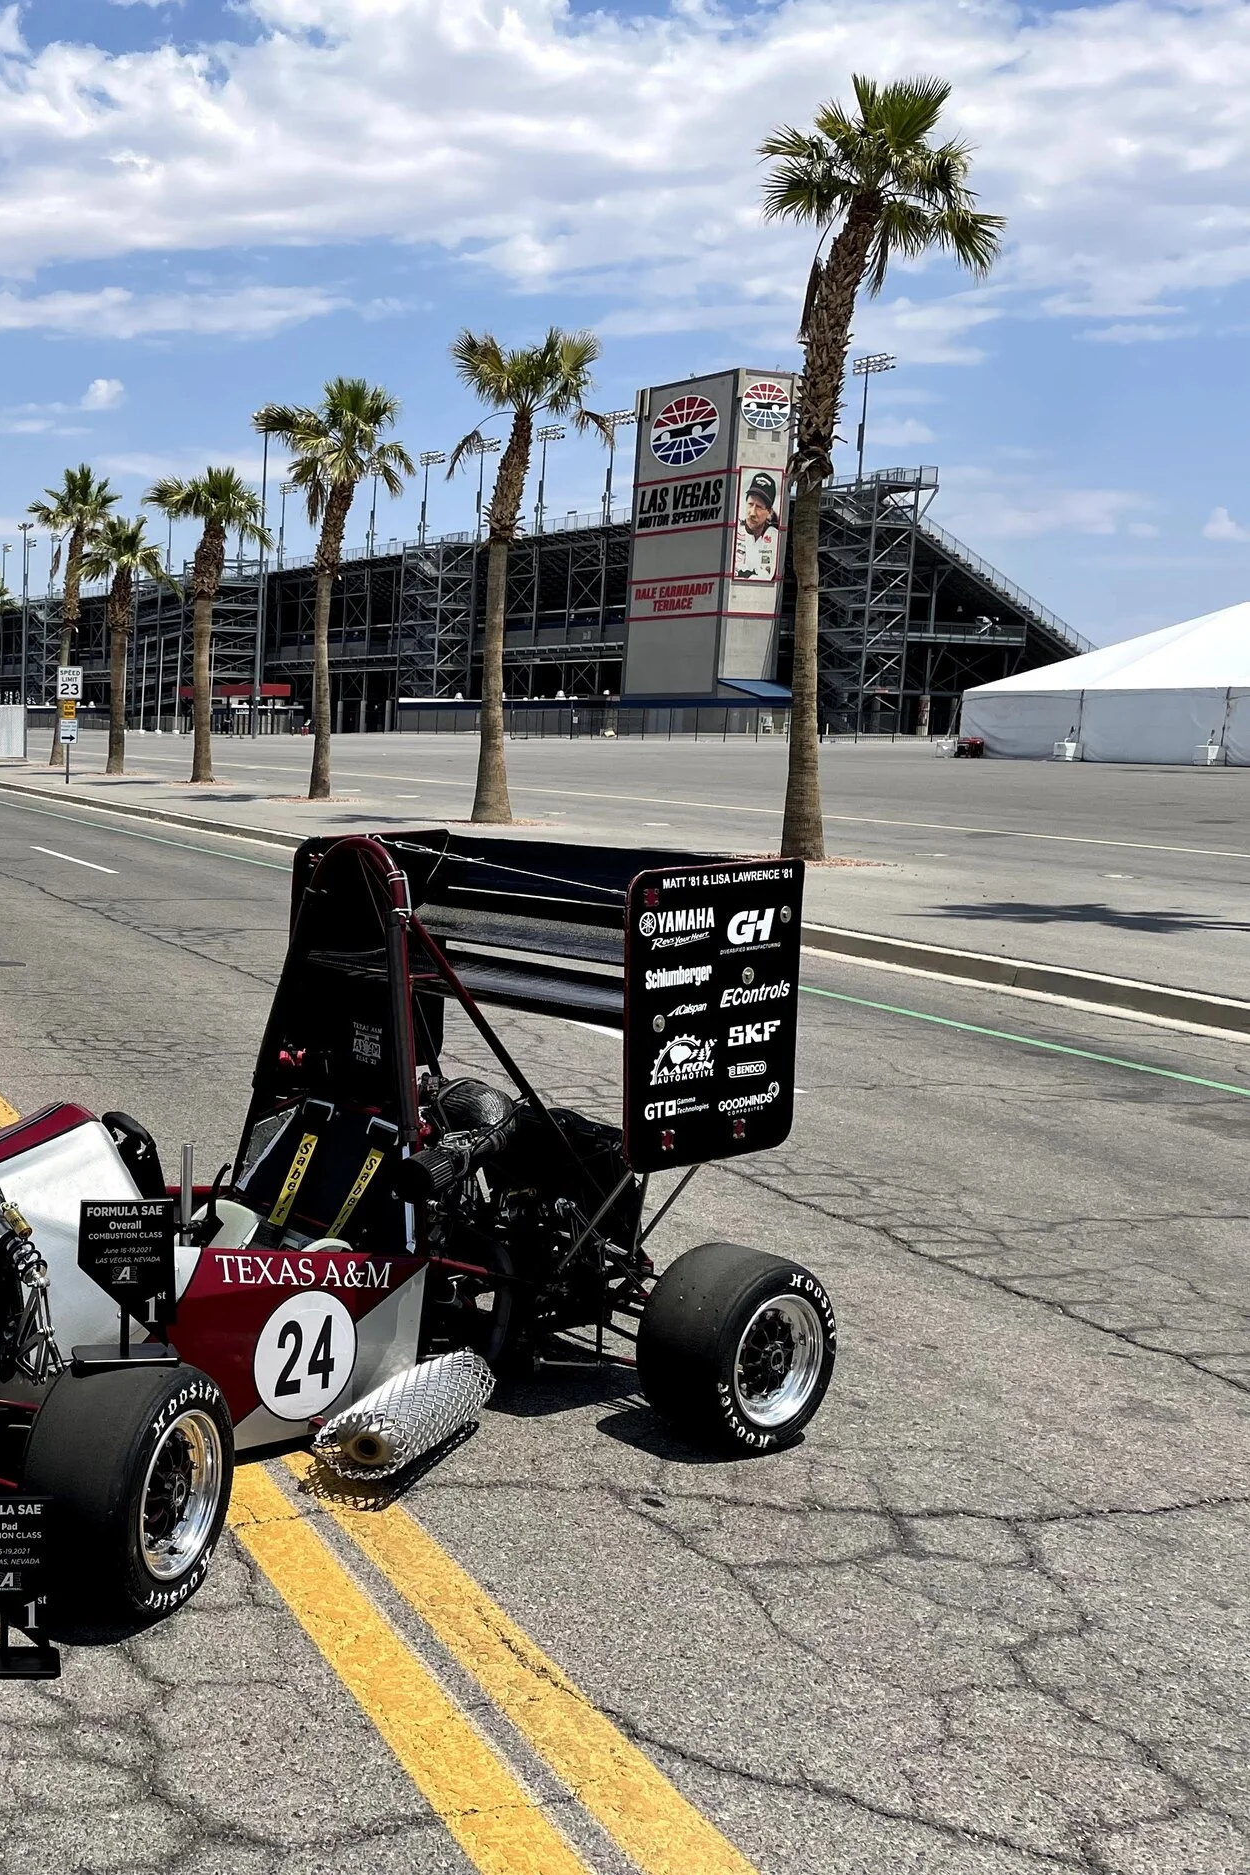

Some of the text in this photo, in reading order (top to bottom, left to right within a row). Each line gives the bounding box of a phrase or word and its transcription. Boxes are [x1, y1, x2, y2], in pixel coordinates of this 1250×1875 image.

[639, 479, 723, 514] LAS VEGAS
[637, 506, 722, 529] MOTOR SPEEDWAY
[634, 582, 714, 600] DALE EARNHARDT
[653, 597, 693, 612] TERRACE
[60, 683, 79, 695] 23
[663, 877, 686, 889] MATT
[702, 875, 709, 885] &
[711, 873, 730, 884] LISA
[733, 869, 780, 883] LAWRENCE
[657, 907, 715, 933] YAMAHA
[645, 965, 712, 989] Schlumberger
[720, 979, 791, 1008] EControls
[678, 1002, 707, 1016] Calspan
[727, 1019, 781, 1047] SKF
[657, 1059, 715, 1077] AARON
[657, 1069, 714, 1085] AUTOMOTIVE
[677, 1096, 696, 1105] Gamma
[677, 1102, 709, 1115] Technologies
[718, 1092, 773, 1112] GOODWINDS
[727, 1105, 764, 1116] COMPOSITES
[276, 1142, 312, 1218] Sabelt
[333, 1158, 377, 1233] Sabelt
[86, 1205, 163, 1217] FORMULA SAE
[109, 1220, 142, 1230] Overall
[215, 1255, 392, 1288] TEXAS A&M
[144, 1290, 167, 1323] 1st
[274, 1315, 335, 1397] 24
[153, 1380, 220, 1438] Hoosier
[17, 1504, 42, 1515] SAE
[1, 1522, 18, 1531] Pad
[15, 1531, 42, 1539] CLASS
[23, 1594, 47, 1629] 1st
